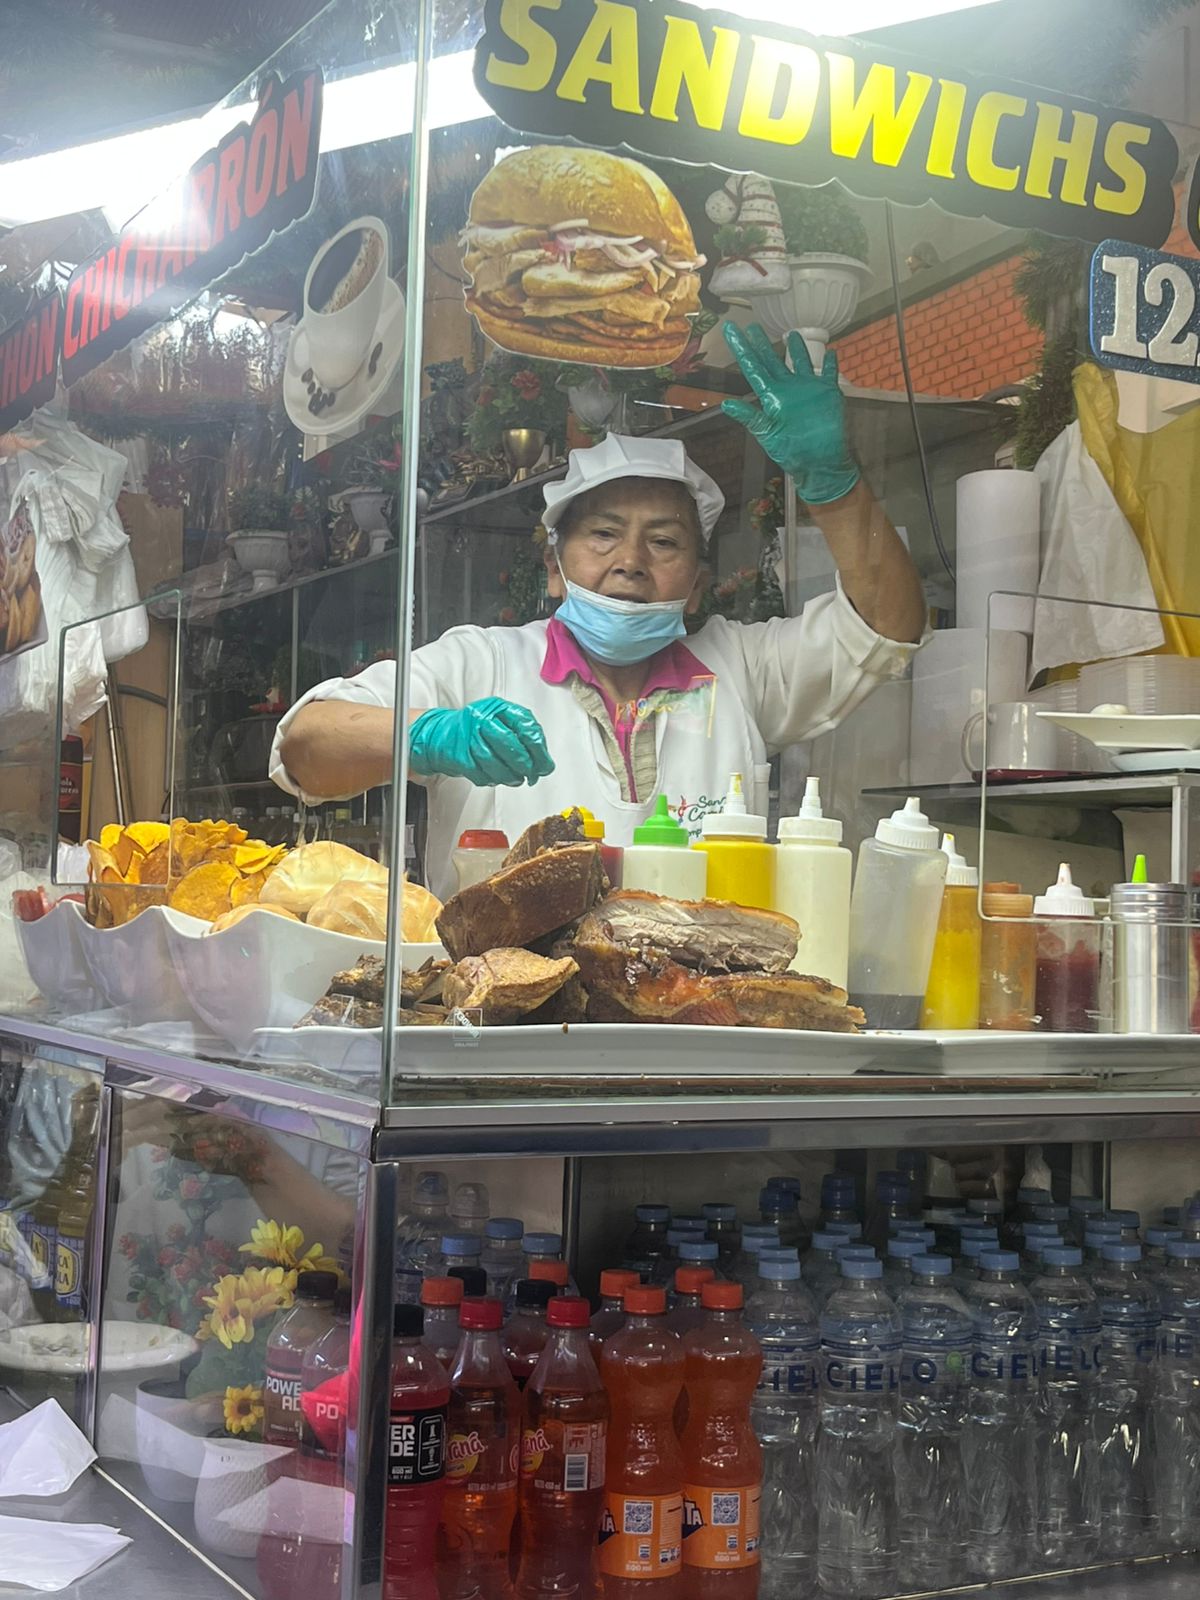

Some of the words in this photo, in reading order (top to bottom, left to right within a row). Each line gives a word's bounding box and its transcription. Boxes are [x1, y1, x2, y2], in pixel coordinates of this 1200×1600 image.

[485, 0, 1151, 215] SANDWICHS
[0, 298, 59, 408] HON
[1101, 254, 1200, 366] 12
[389, 1441, 415, 1456] DE
[390, 1424, 415, 1440] ER
